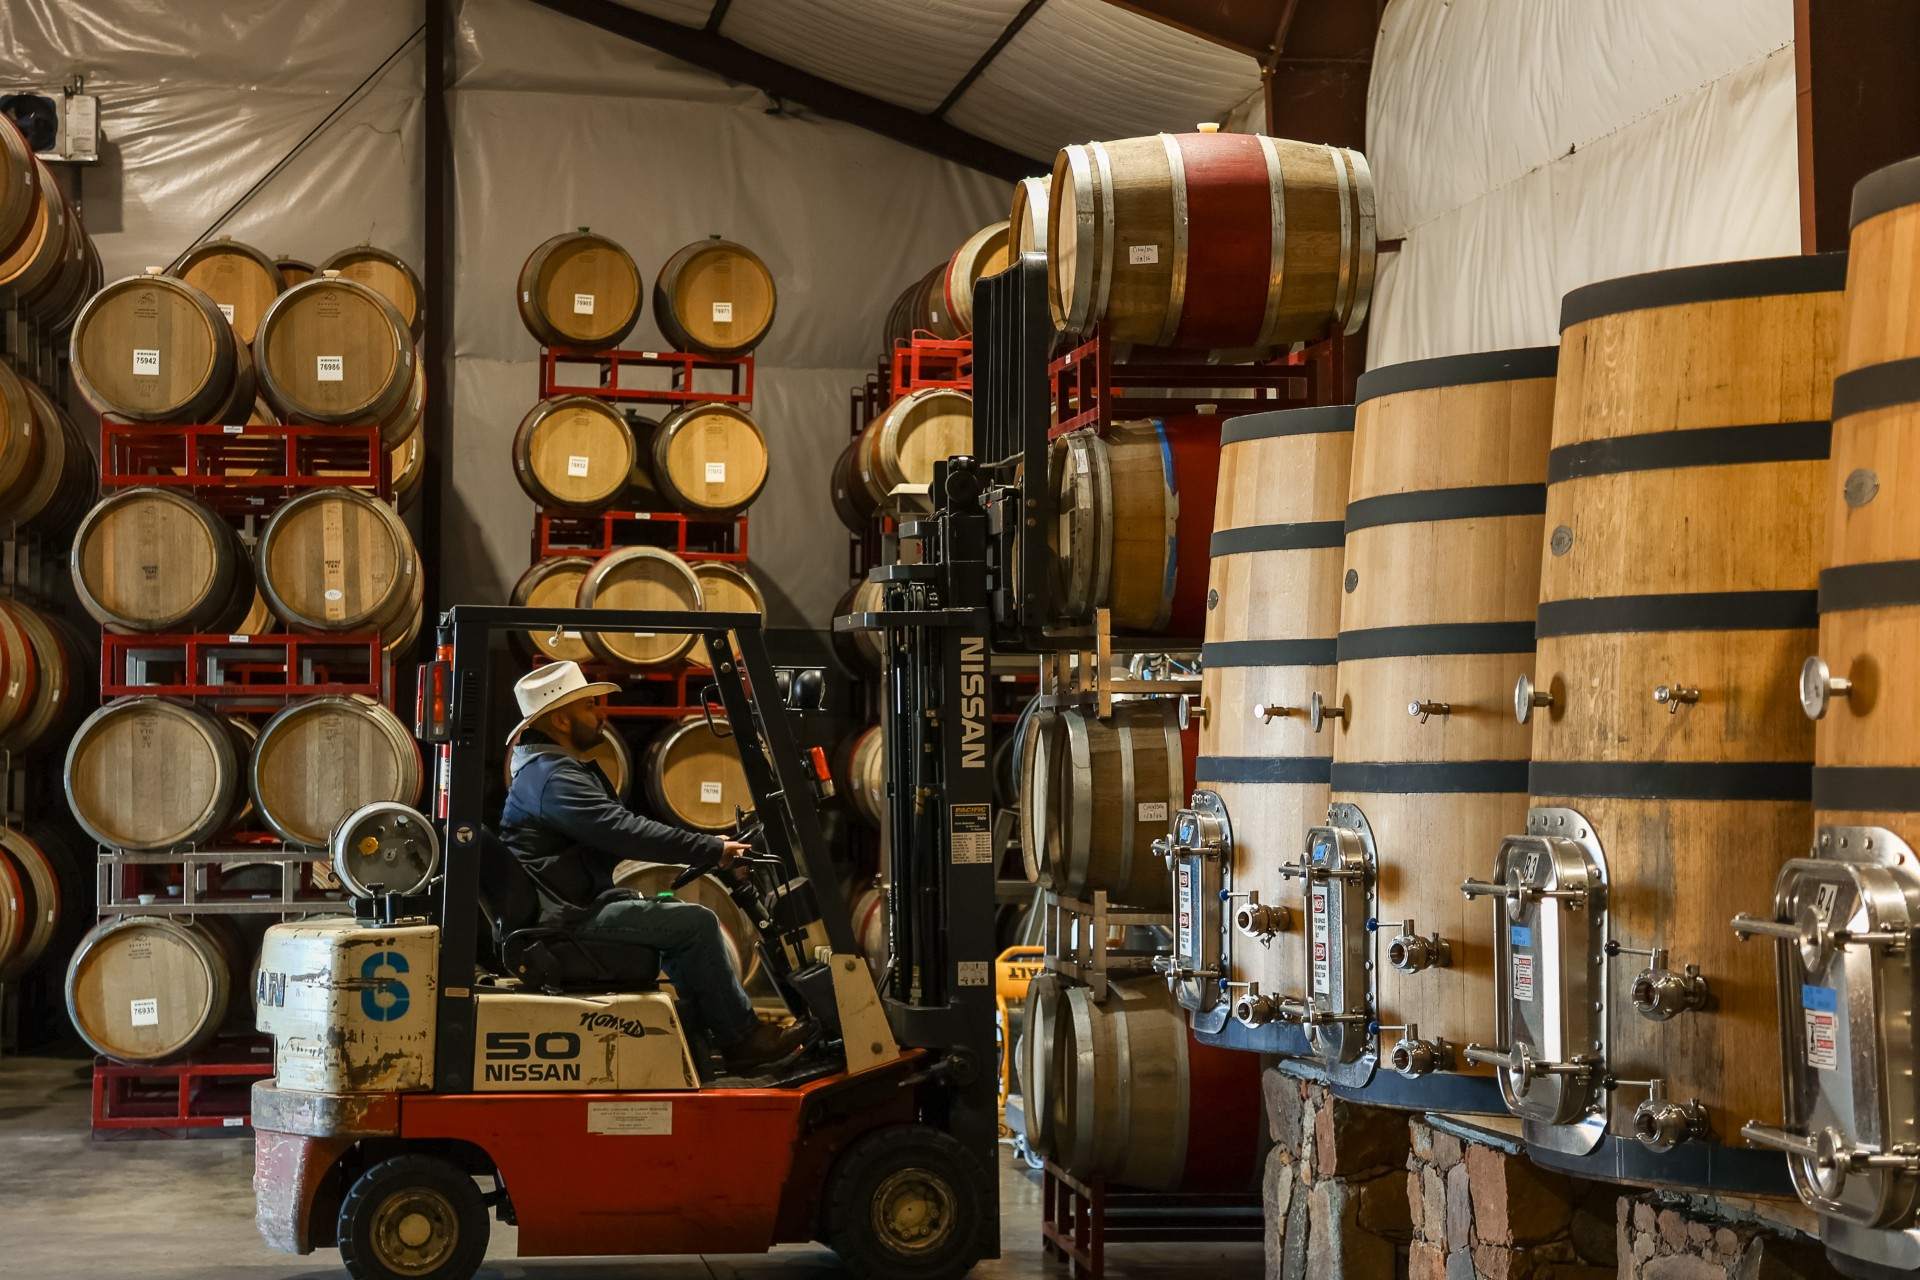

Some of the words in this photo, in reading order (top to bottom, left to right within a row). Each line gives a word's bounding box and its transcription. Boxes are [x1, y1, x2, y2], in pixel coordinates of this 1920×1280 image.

[136, 357, 157, 365] 75942
[320, 363, 340, 371] 76986
[960, 636, 985, 768] NISSAN
[955, 806, 987, 814] PACIFIC
[361, 951, 410, 1022] 6
[134, 1007, 155, 1015] 76935
[486, 1031, 581, 1060] 50
[485, 1063, 581, 1082] NISSAN
